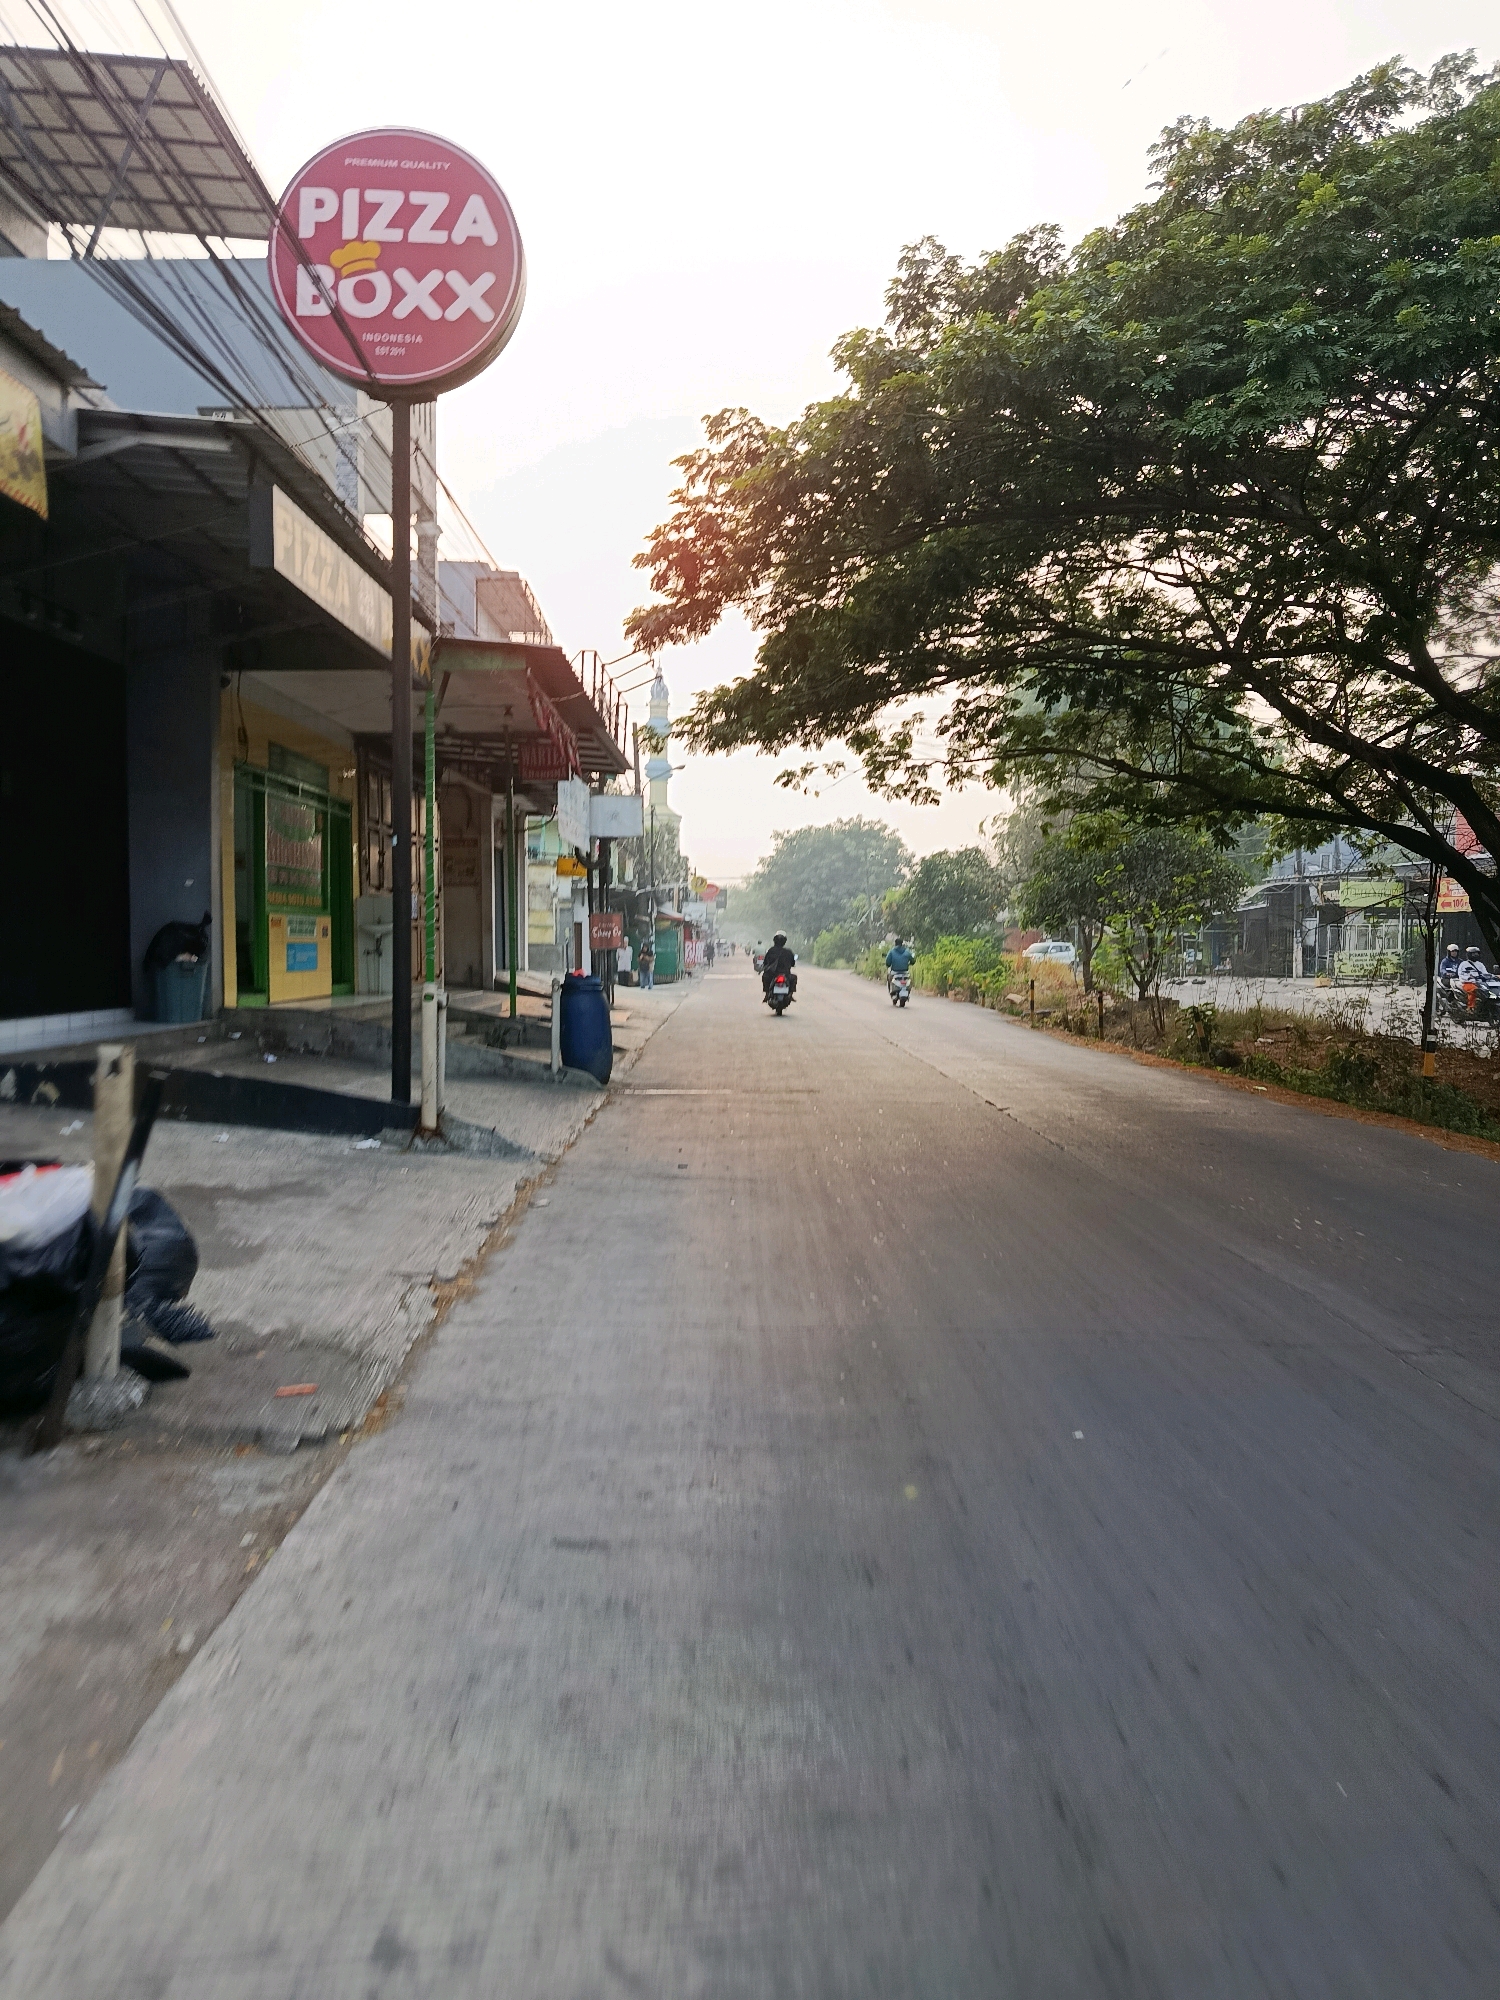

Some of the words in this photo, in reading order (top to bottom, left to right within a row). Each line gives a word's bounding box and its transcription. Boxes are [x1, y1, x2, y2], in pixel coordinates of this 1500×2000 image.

[344, 157, 399, 168] PREMIUM
[400, 159, 452, 170] QUALITY
[298, 186, 498, 247] PIZZA
[296, 263, 497, 323] BOXX
[362, 332, 424, 343] INDONESIA
[274, 503, 350, 610] PIZZA
